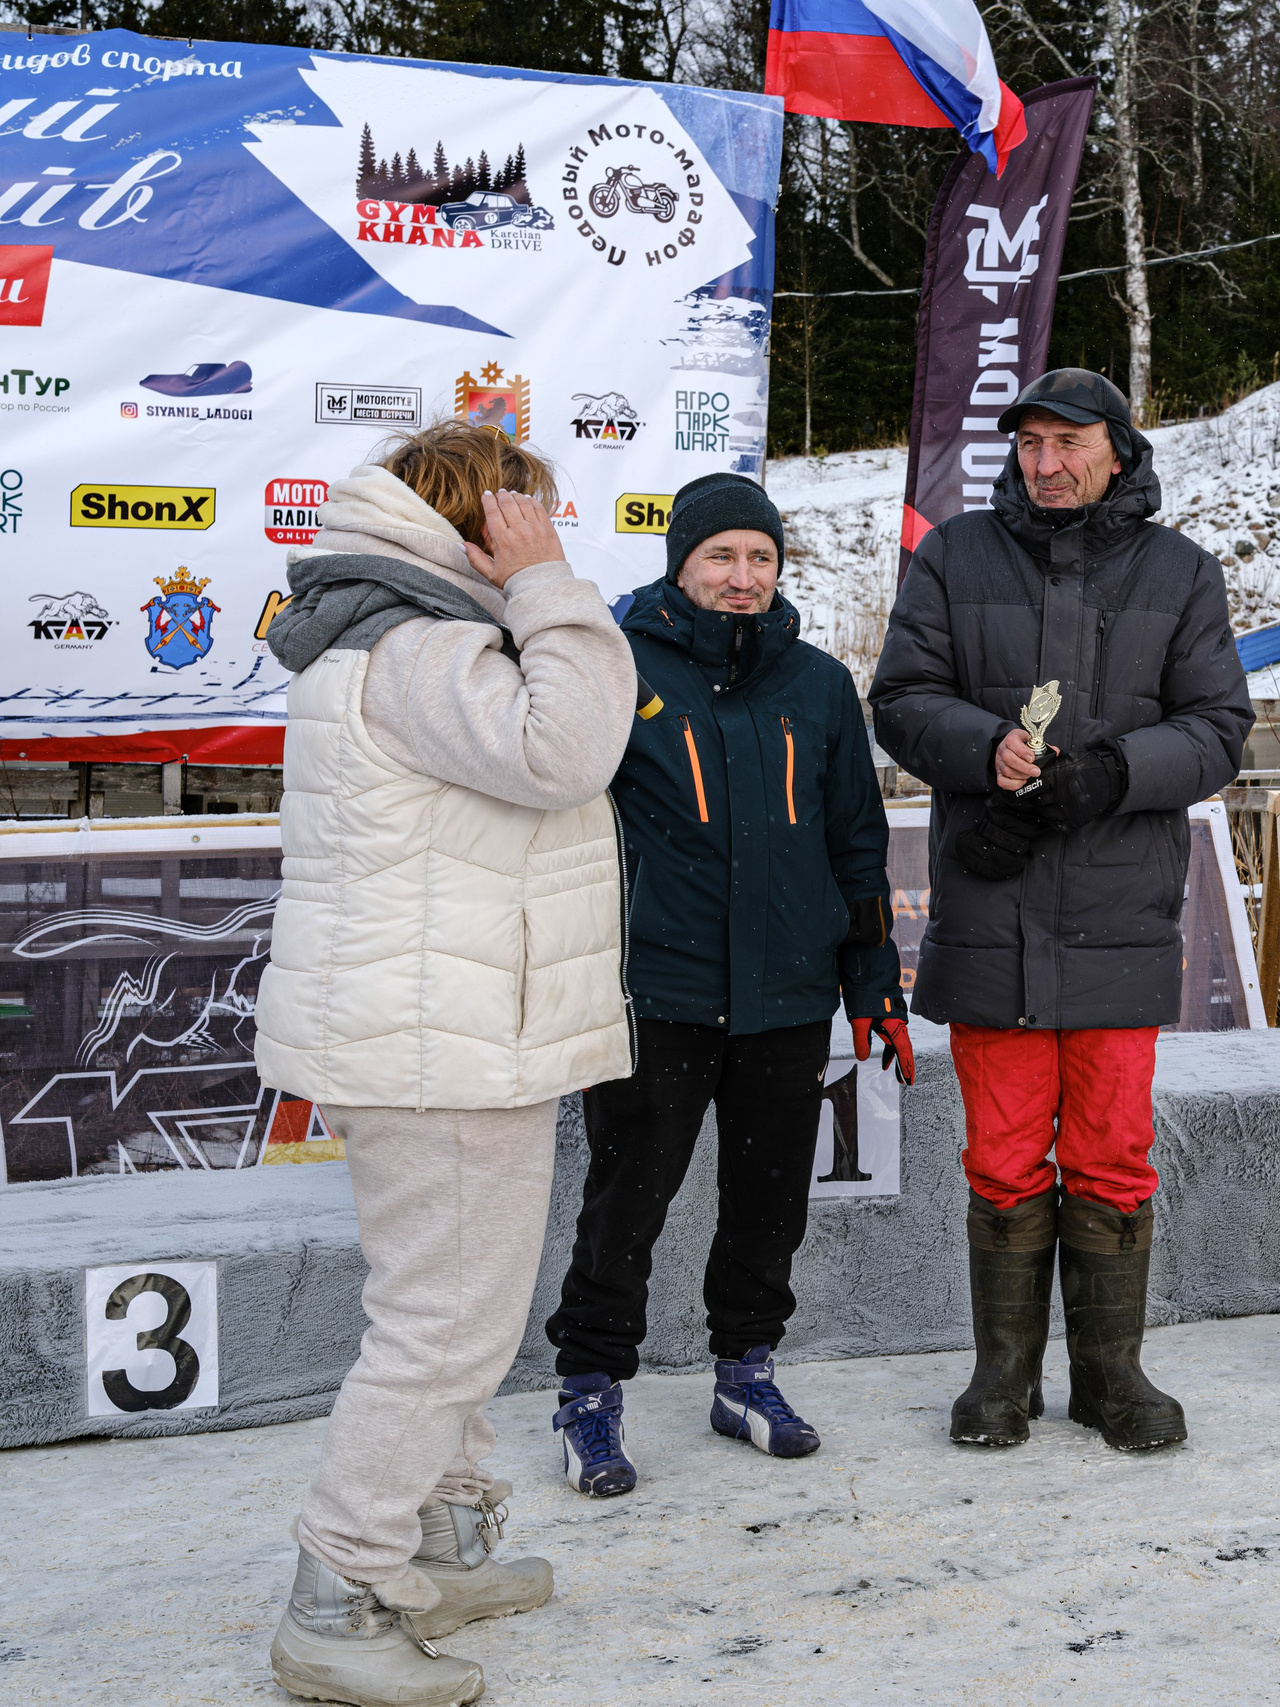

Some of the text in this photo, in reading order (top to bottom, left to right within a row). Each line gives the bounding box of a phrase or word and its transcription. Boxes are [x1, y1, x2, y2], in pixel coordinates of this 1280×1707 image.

[101, 50, 243, 82] спорта
[356, 198, 440, 226] GYM
[562, 145, 627, 266] Ледовый
[486, 213, 496, 224] 17
[356, 220, 485, 249] KHANA
[490, 229, 542, 239] Karelian
[491, 238, 543, 251] DRIVE
[17, 403, 31, 411] по
[33, 403, 71, 413] России
[675, 390, 730, 413] АГРО
[146, 405, 253, 421] SIYANIE_LADOGI
[356, 408, 413, 420] МЕСТО ВСТРЕЧИ
[675, 411, 730, 433] ПАРК
[593, 443, 626, 451] GERMANY
[272, 482, 325, 505] MOTO
[80, 492, 211, 523] ShonX
[272, 530, 315, 541] .ONLIN
[1014, 778, 1043, 798] reusch
[816, 1063, 872, 1183] 1
[102, 1272, 200, 1412] 3
